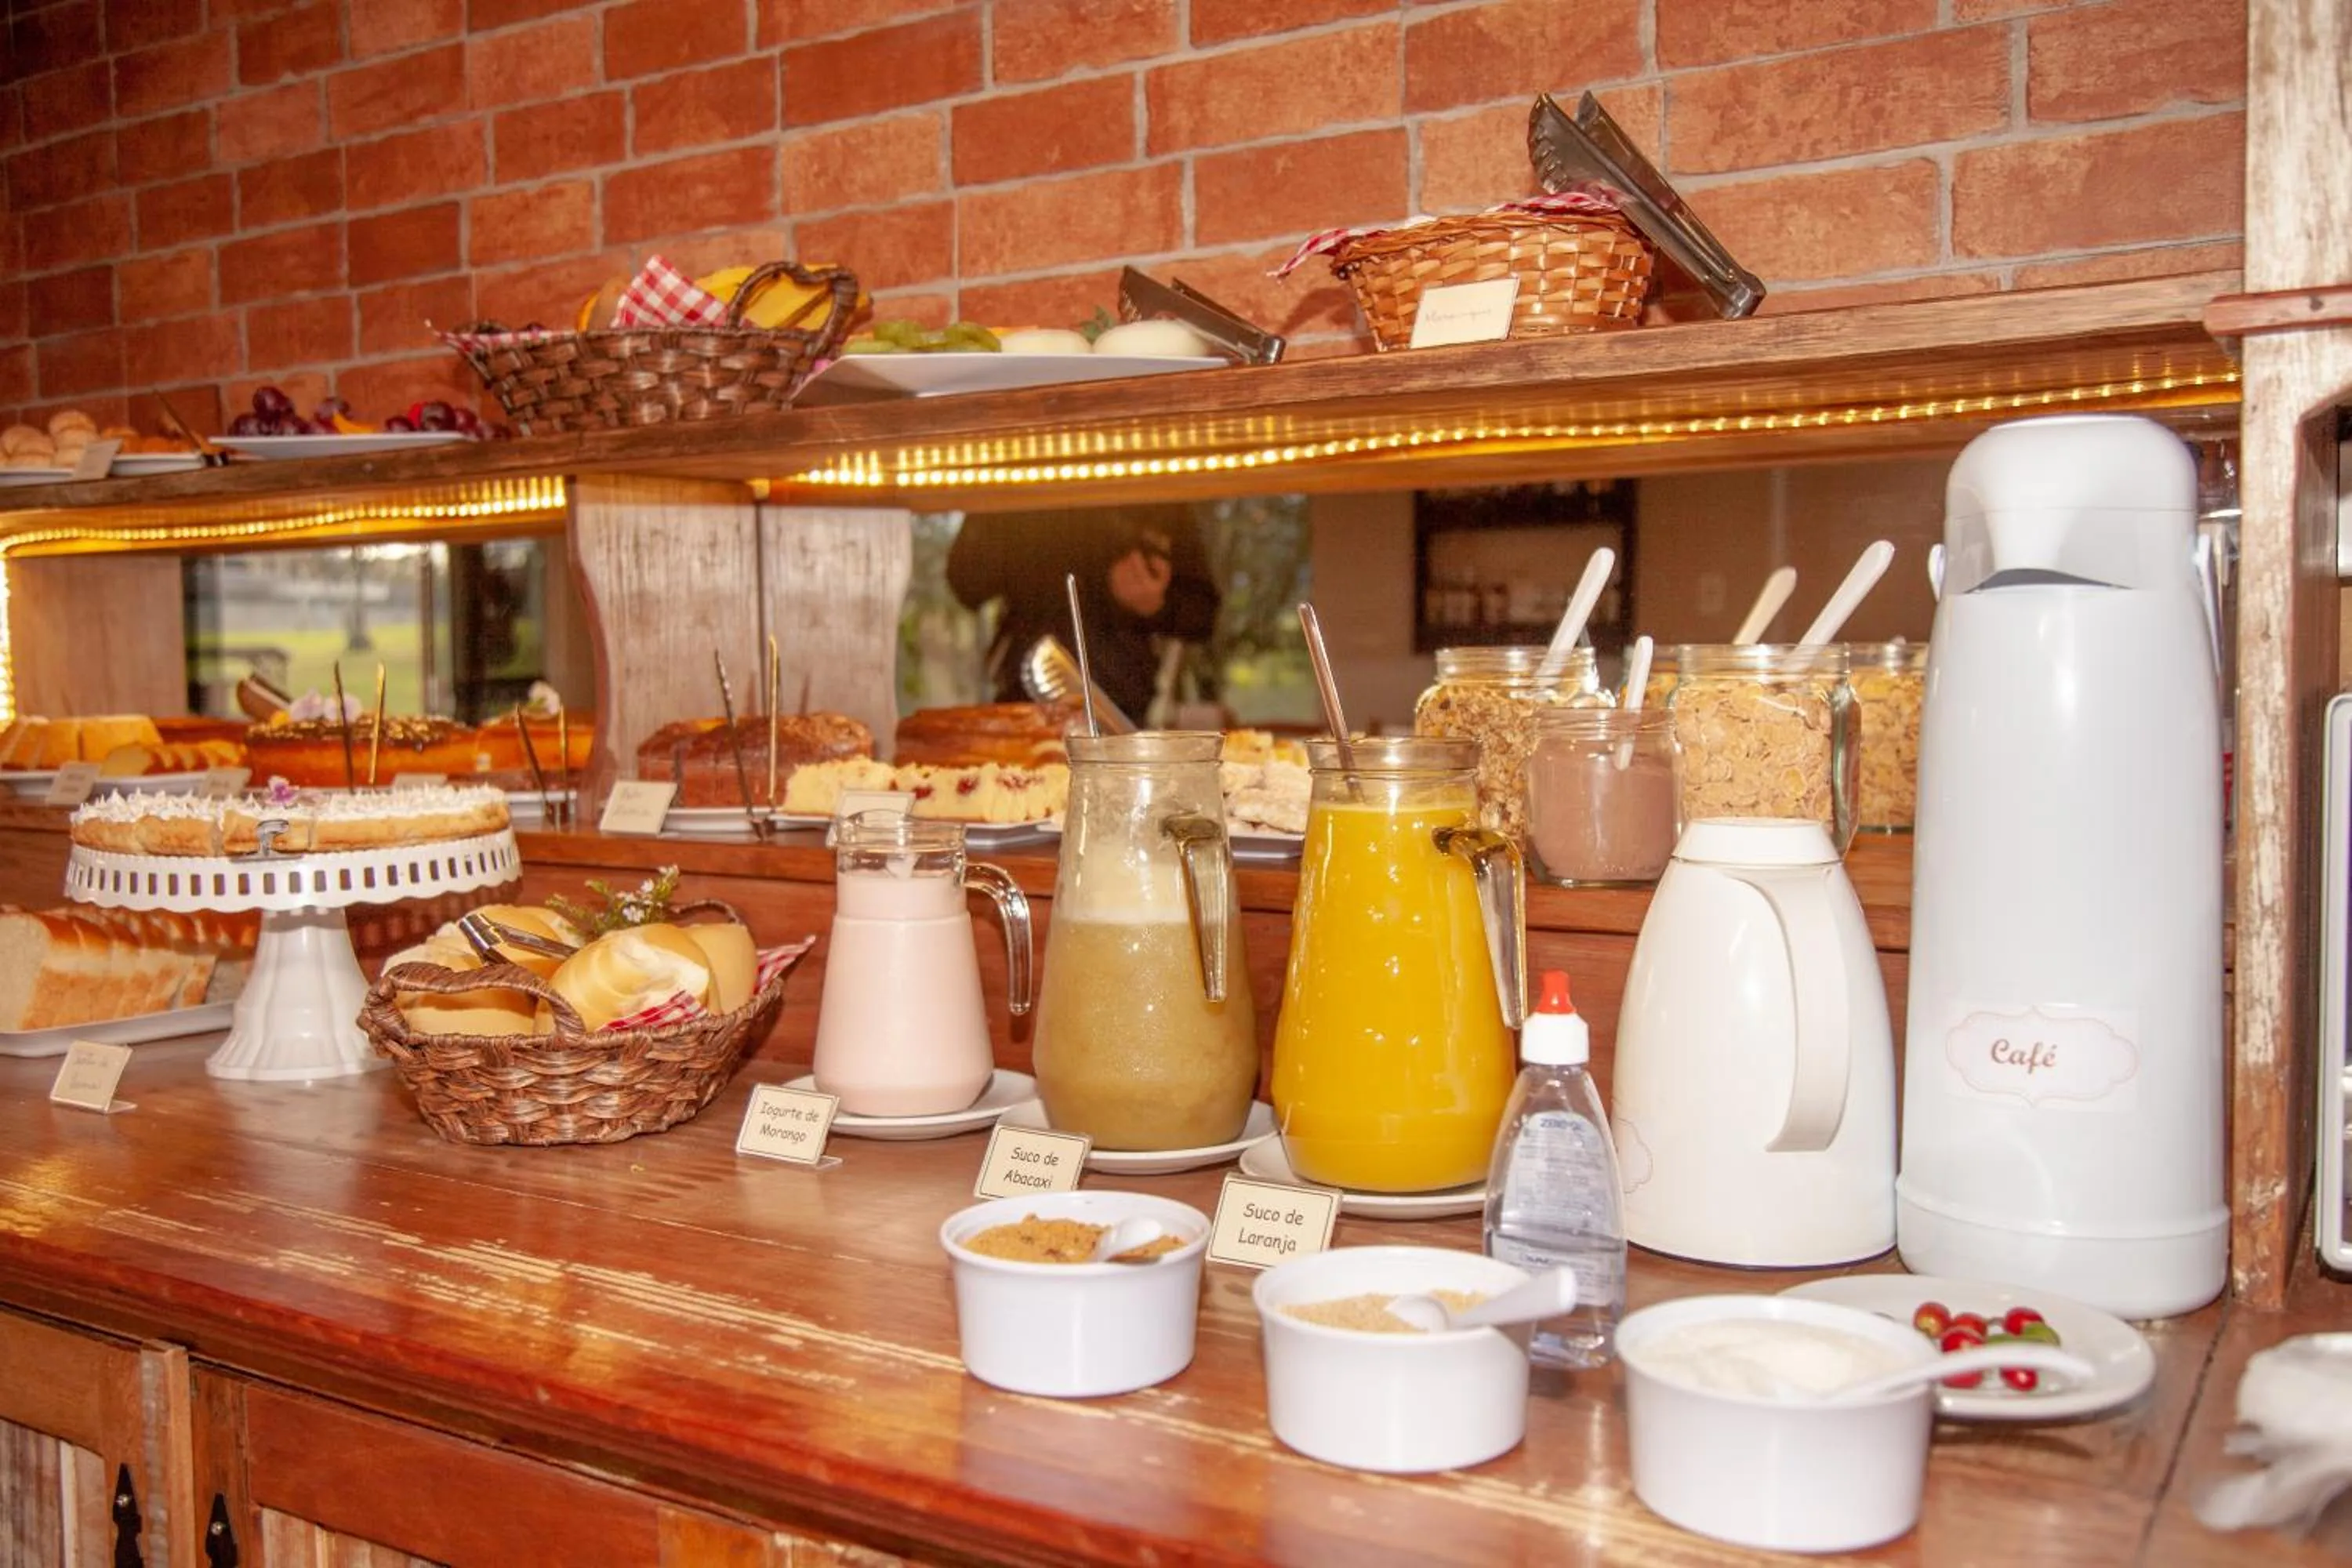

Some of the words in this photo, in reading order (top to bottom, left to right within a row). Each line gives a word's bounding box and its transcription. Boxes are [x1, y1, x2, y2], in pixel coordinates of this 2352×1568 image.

[1990, 1038, 2057, 1075] Café
[759, 1101, 804, 1122] Iogurte
[805, 1109, 820, 1123] de
[759, 1122, 807, 1145] Morango
[1011, 1147, 1040, 1163] Suco
[1044, 1151, 1060, 1166] de
[1004, 1169, 1054, 1189] Abacaxi
[1243, 1203, 1280, 1222] Suco
[1284, 1210, 1304, 1226] de
[1237, 1227, 1297, 1254] Laranja
